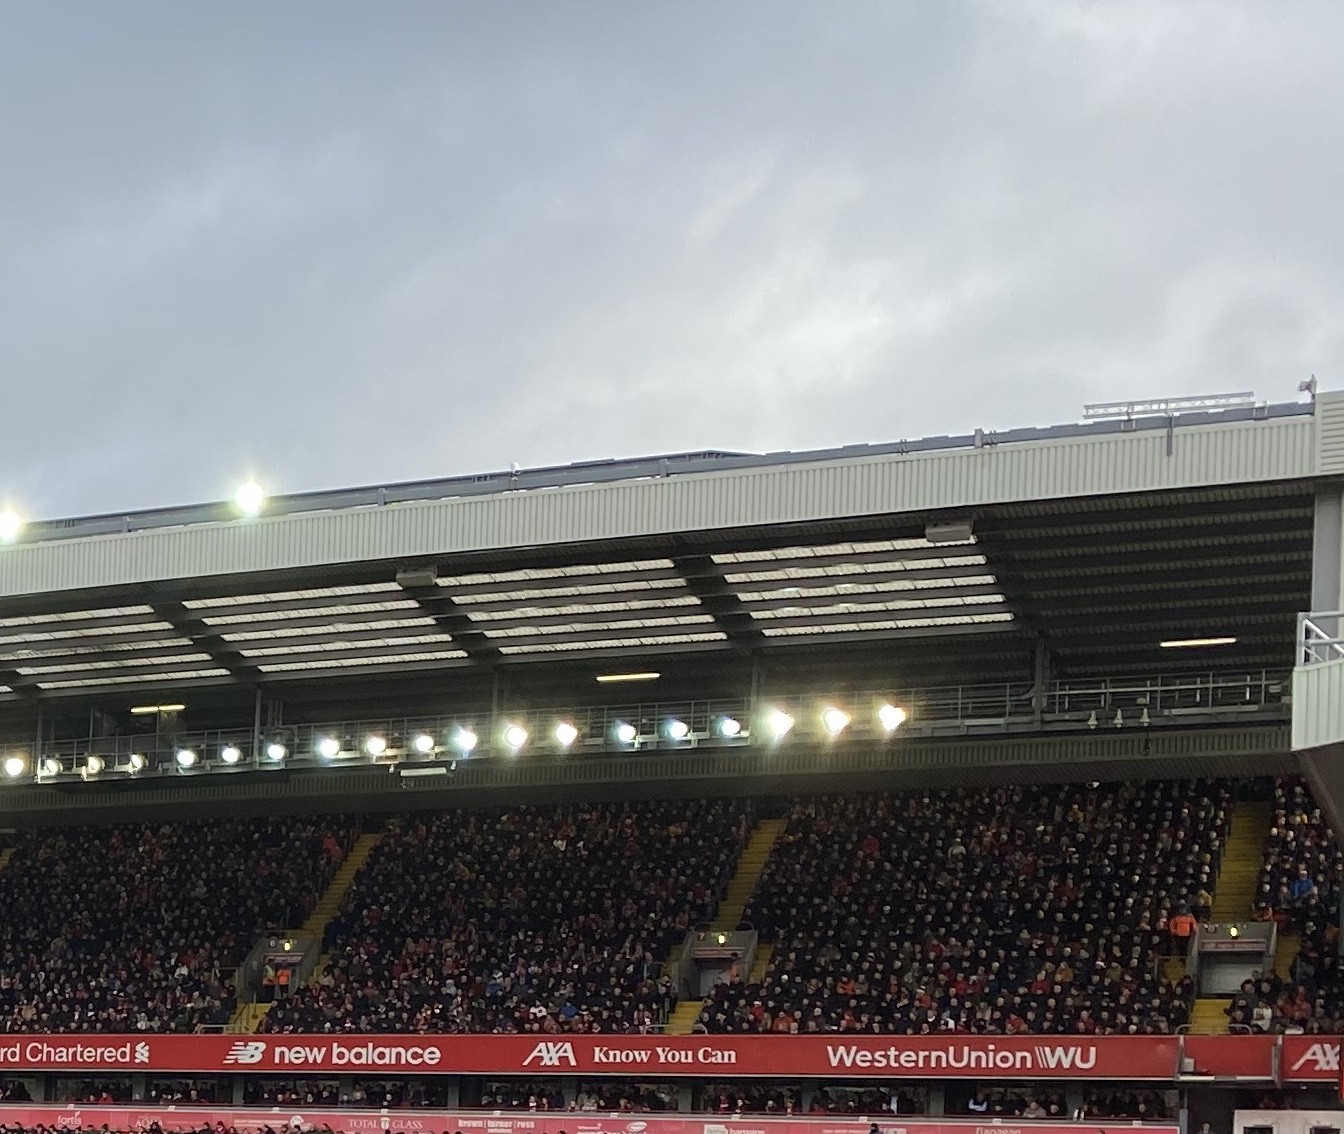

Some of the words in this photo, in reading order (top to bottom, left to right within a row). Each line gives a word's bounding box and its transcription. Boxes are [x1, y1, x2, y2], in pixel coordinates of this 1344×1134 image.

[25, 1042, 130, 1063] Chartered
[274, 1045, 326, 1064] new
[331, 1042, 442, 1065] balance
[522, 1042, 577, 1066] AXA
[593, 1046, 650, 1063] Know
[655, 1047, 693, 1064] You
[697, 1047, 736, 1064] Can
[348, 1119, 378, 1128] TOTAL
[392, 1119, 423, 1129] GLASS
